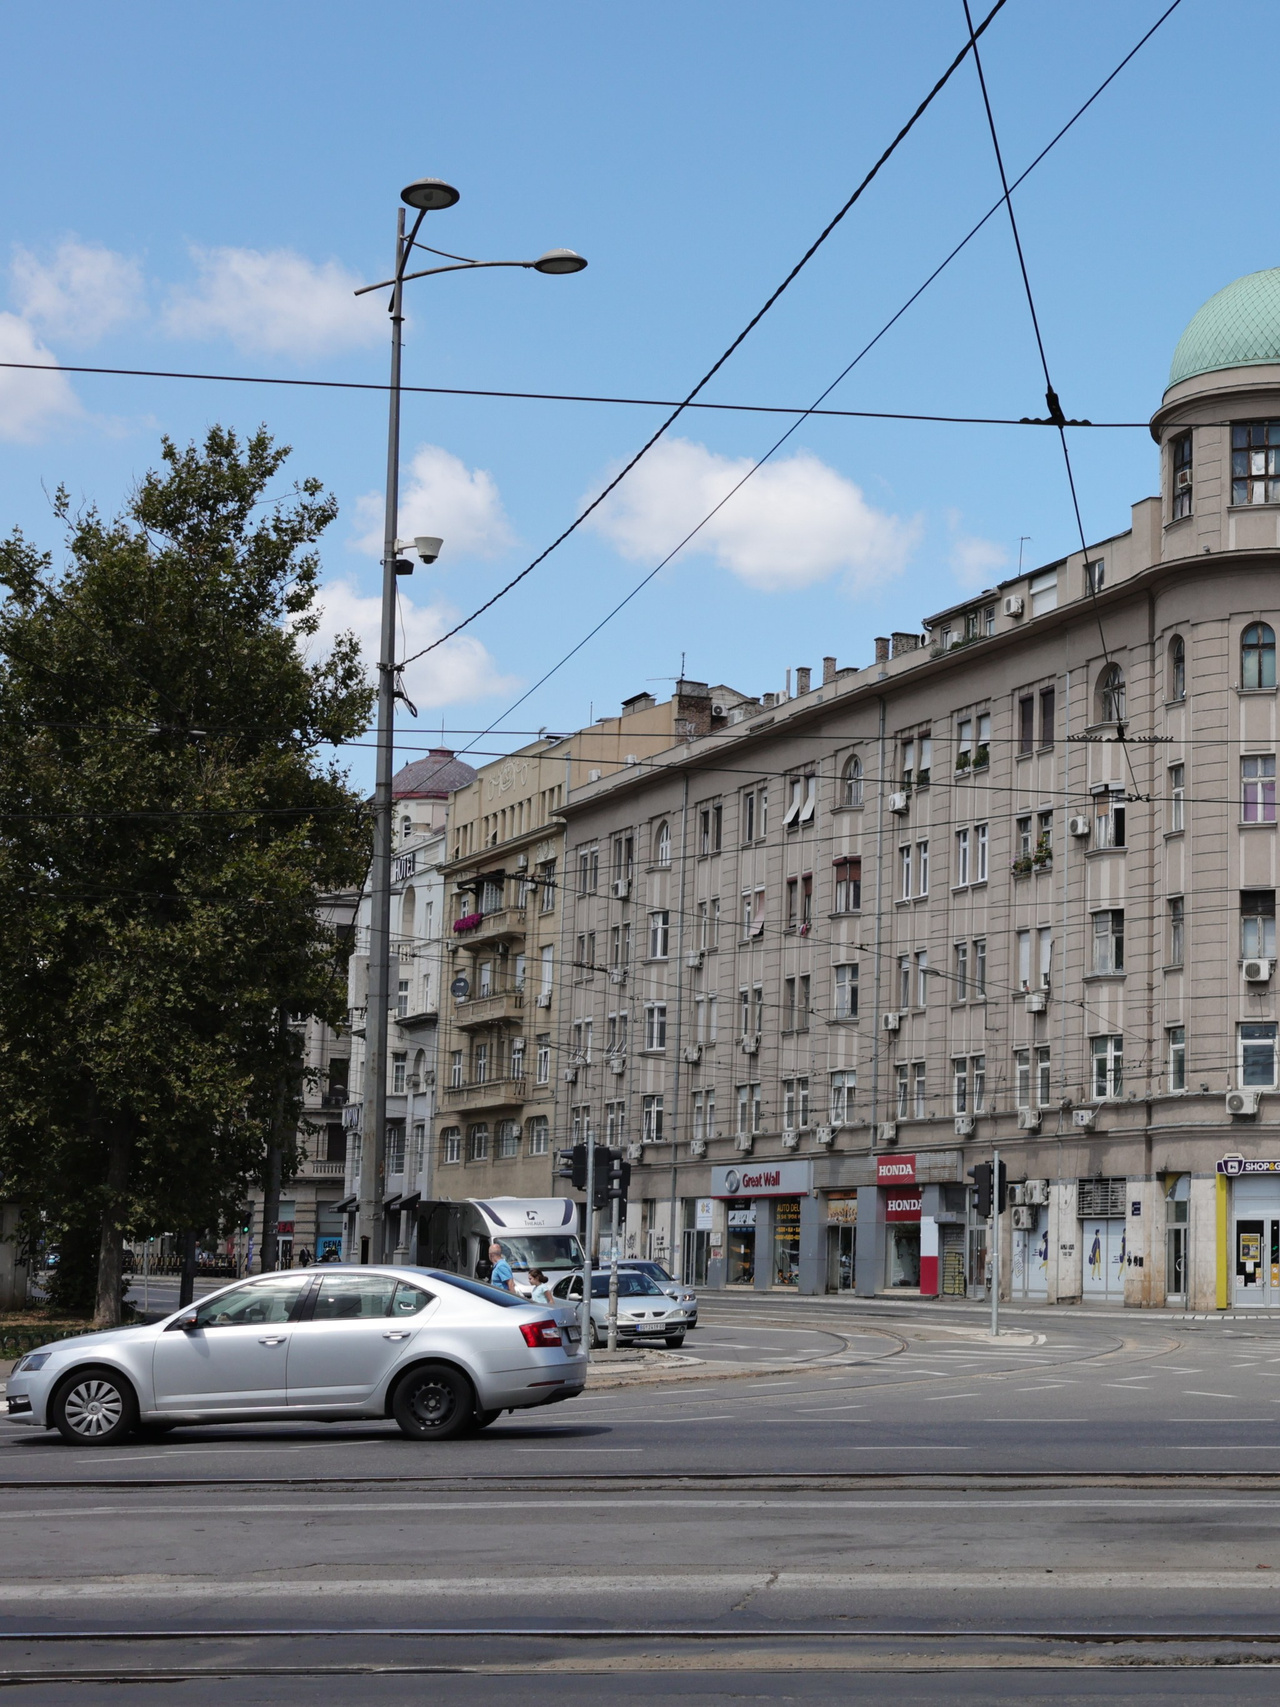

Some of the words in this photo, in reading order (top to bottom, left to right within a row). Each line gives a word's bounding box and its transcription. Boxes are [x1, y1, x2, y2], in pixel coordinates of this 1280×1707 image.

[394, 853, 415, 881] HOTEL
[878, 1164, 914, 1176] HONDA
[742, 1174, 762, 1188] Great
[763, 1171, 780, 1187] Wall
